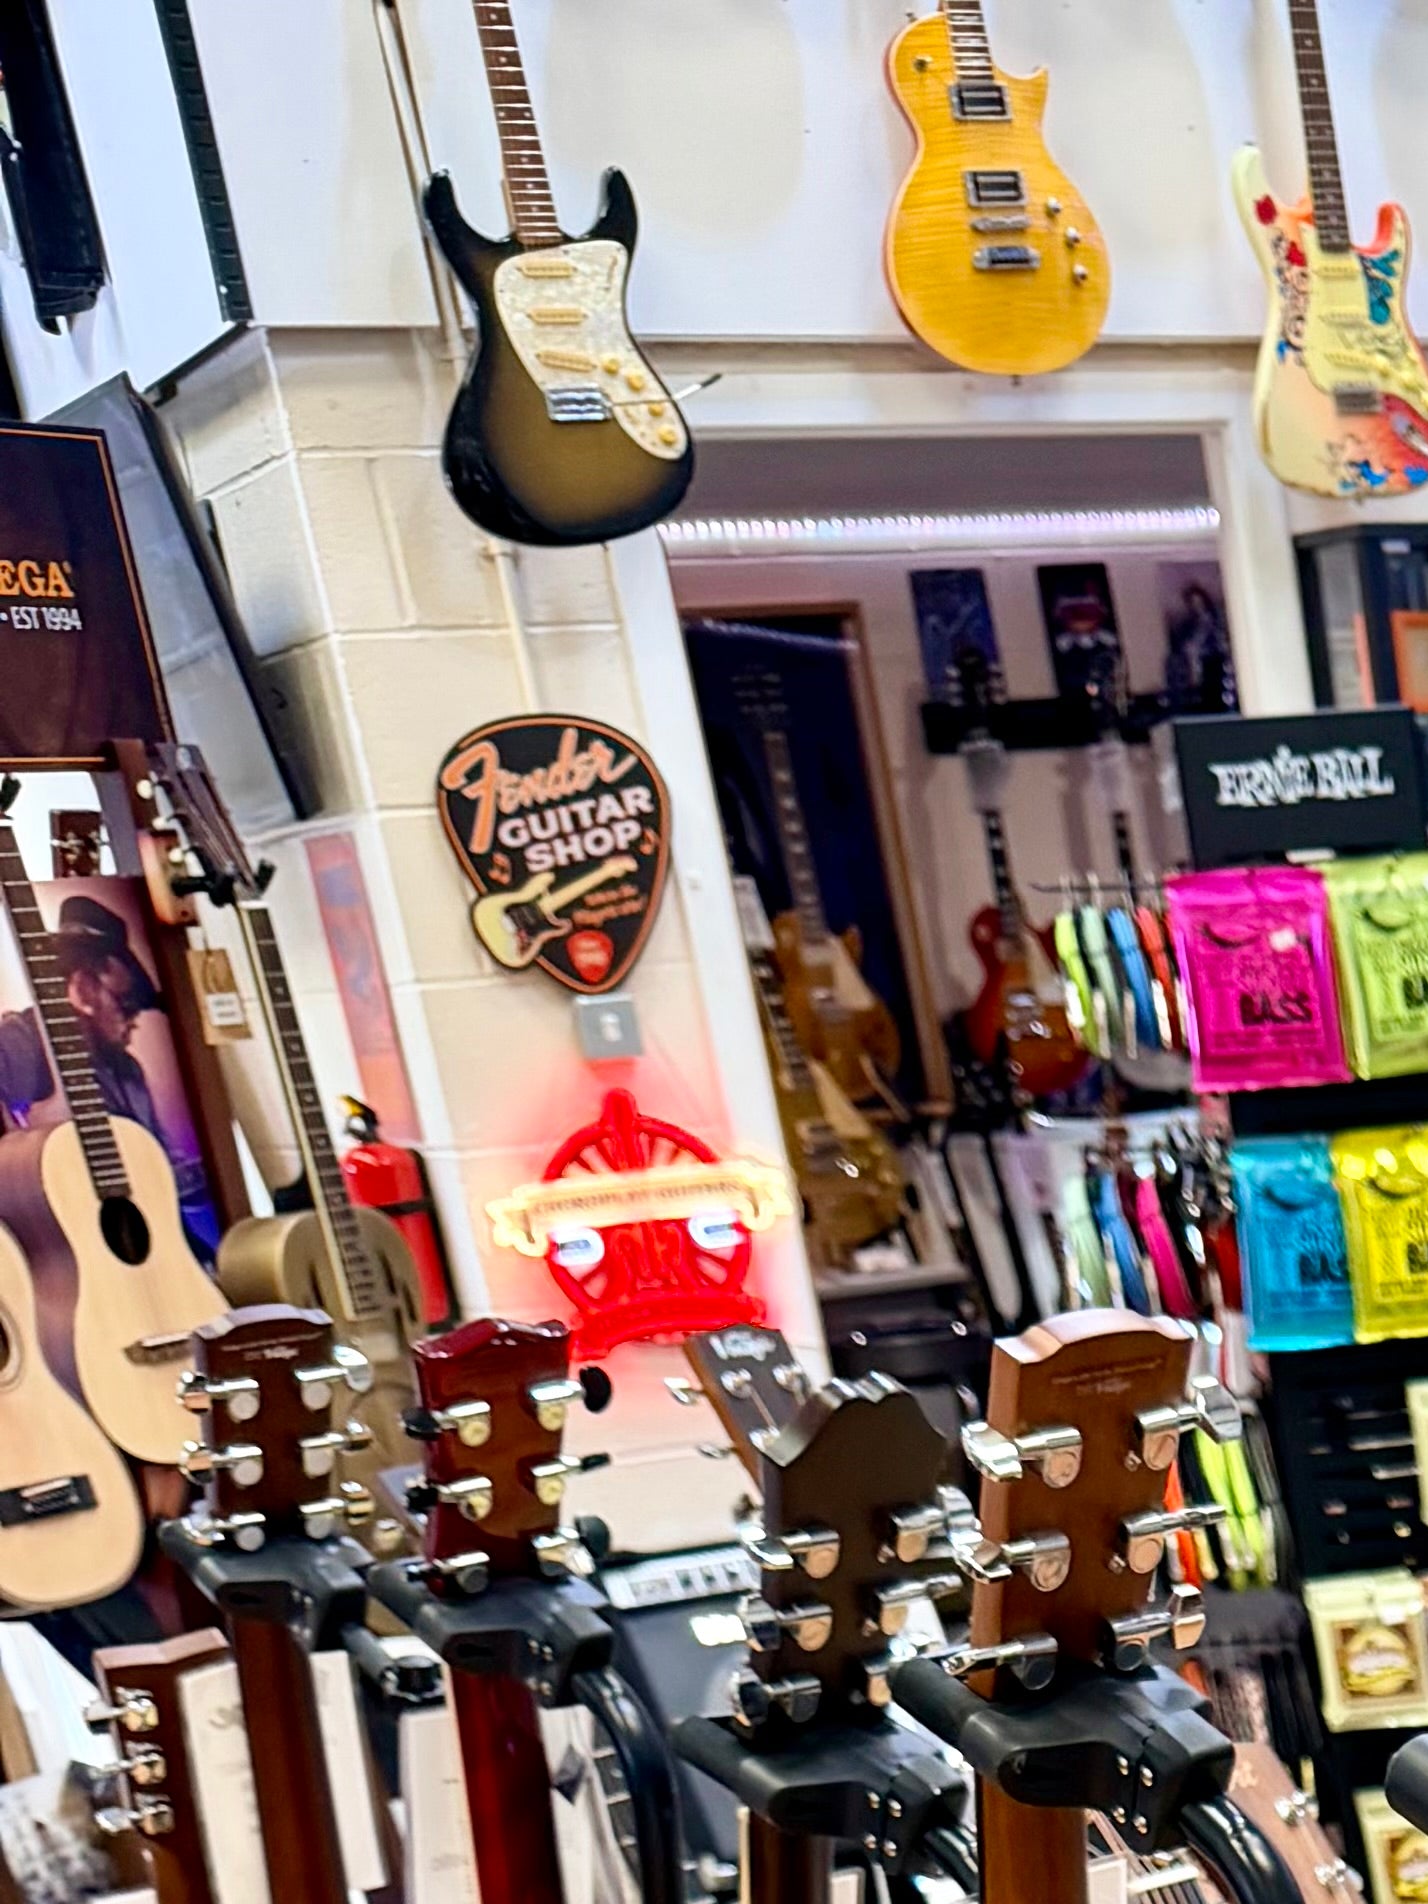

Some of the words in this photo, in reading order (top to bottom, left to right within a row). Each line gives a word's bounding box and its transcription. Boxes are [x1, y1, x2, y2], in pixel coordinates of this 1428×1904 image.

[10, 606, 40, 630] EST
[441, 727, 640, 855] Fender
[1208, 745, 1315, 808] ERNIE
[1309, 746, 1396, 800] BALL
[498, 785, 654, 848] GUITAR
[524, 820, 642, 872] SHOP
